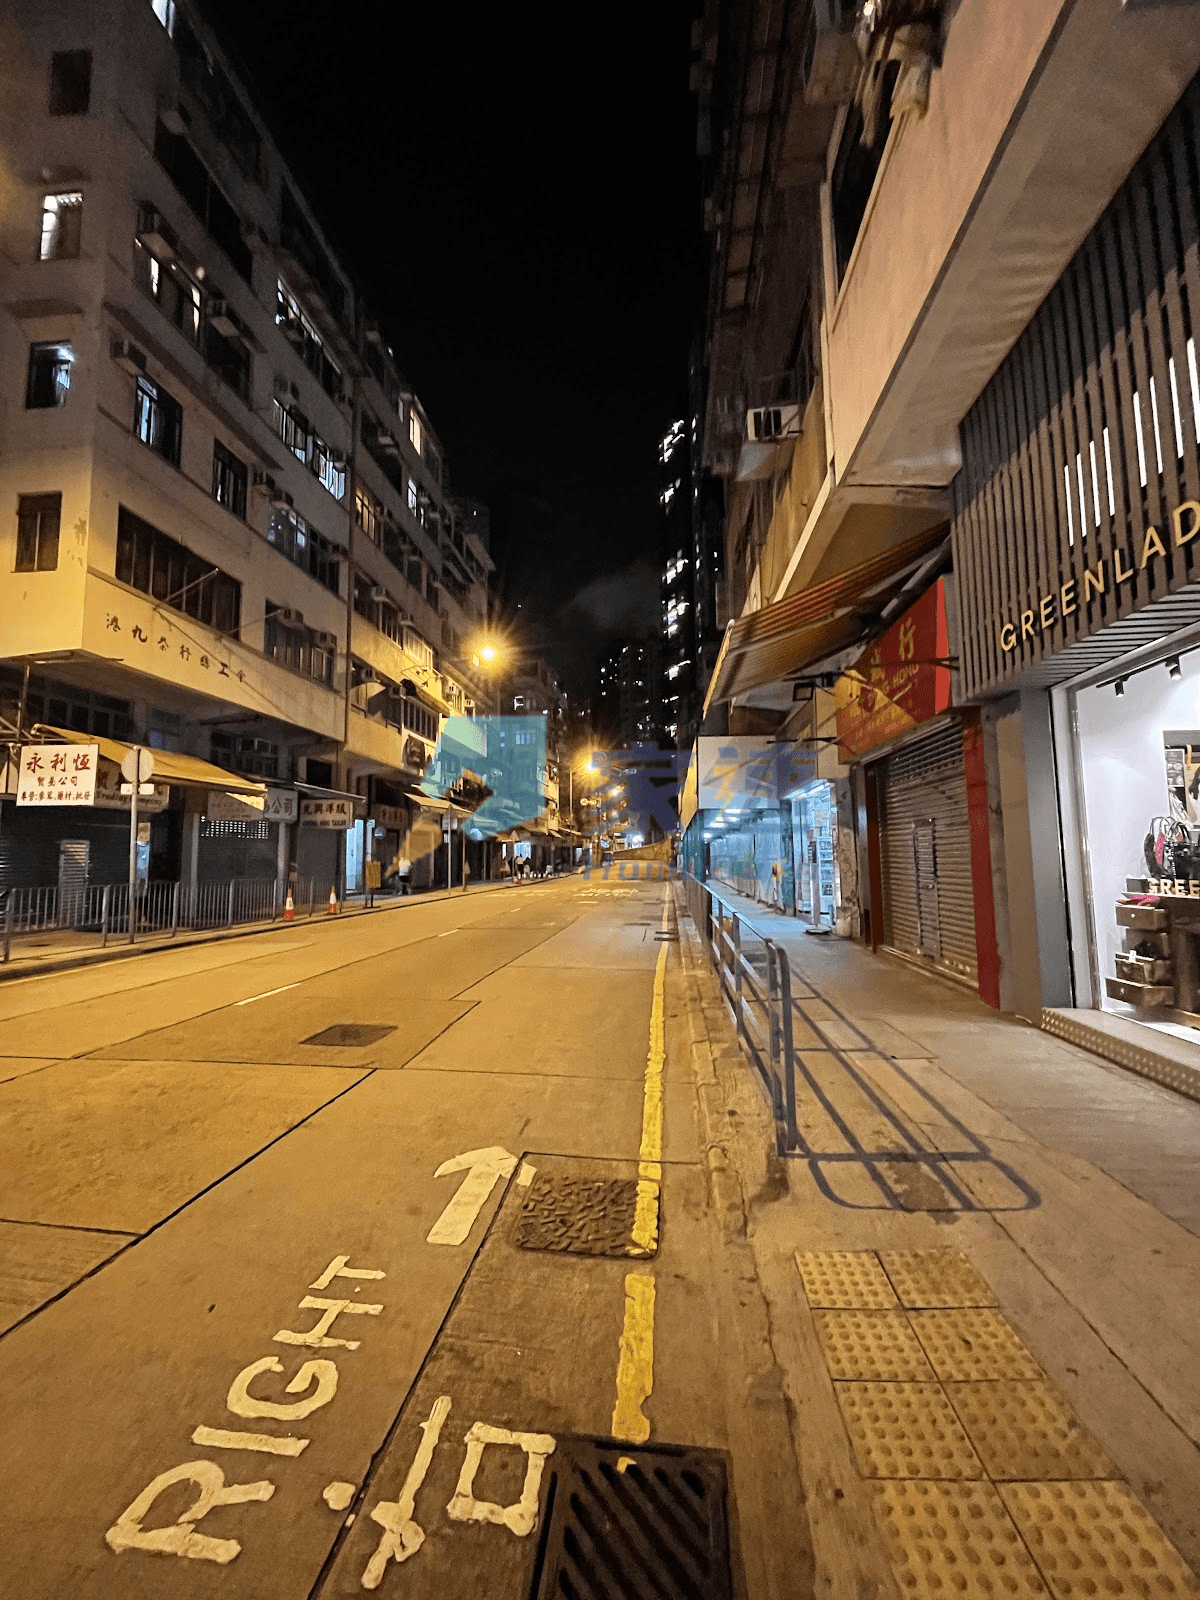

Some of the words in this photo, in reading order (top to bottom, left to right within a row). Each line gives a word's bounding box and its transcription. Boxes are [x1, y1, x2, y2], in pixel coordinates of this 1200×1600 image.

[1000, 500, 1200, 651] GREENLAD
[37, 775, 79, 787] 貿易公司
[105, 1254, 387, 1564] RIGHT
